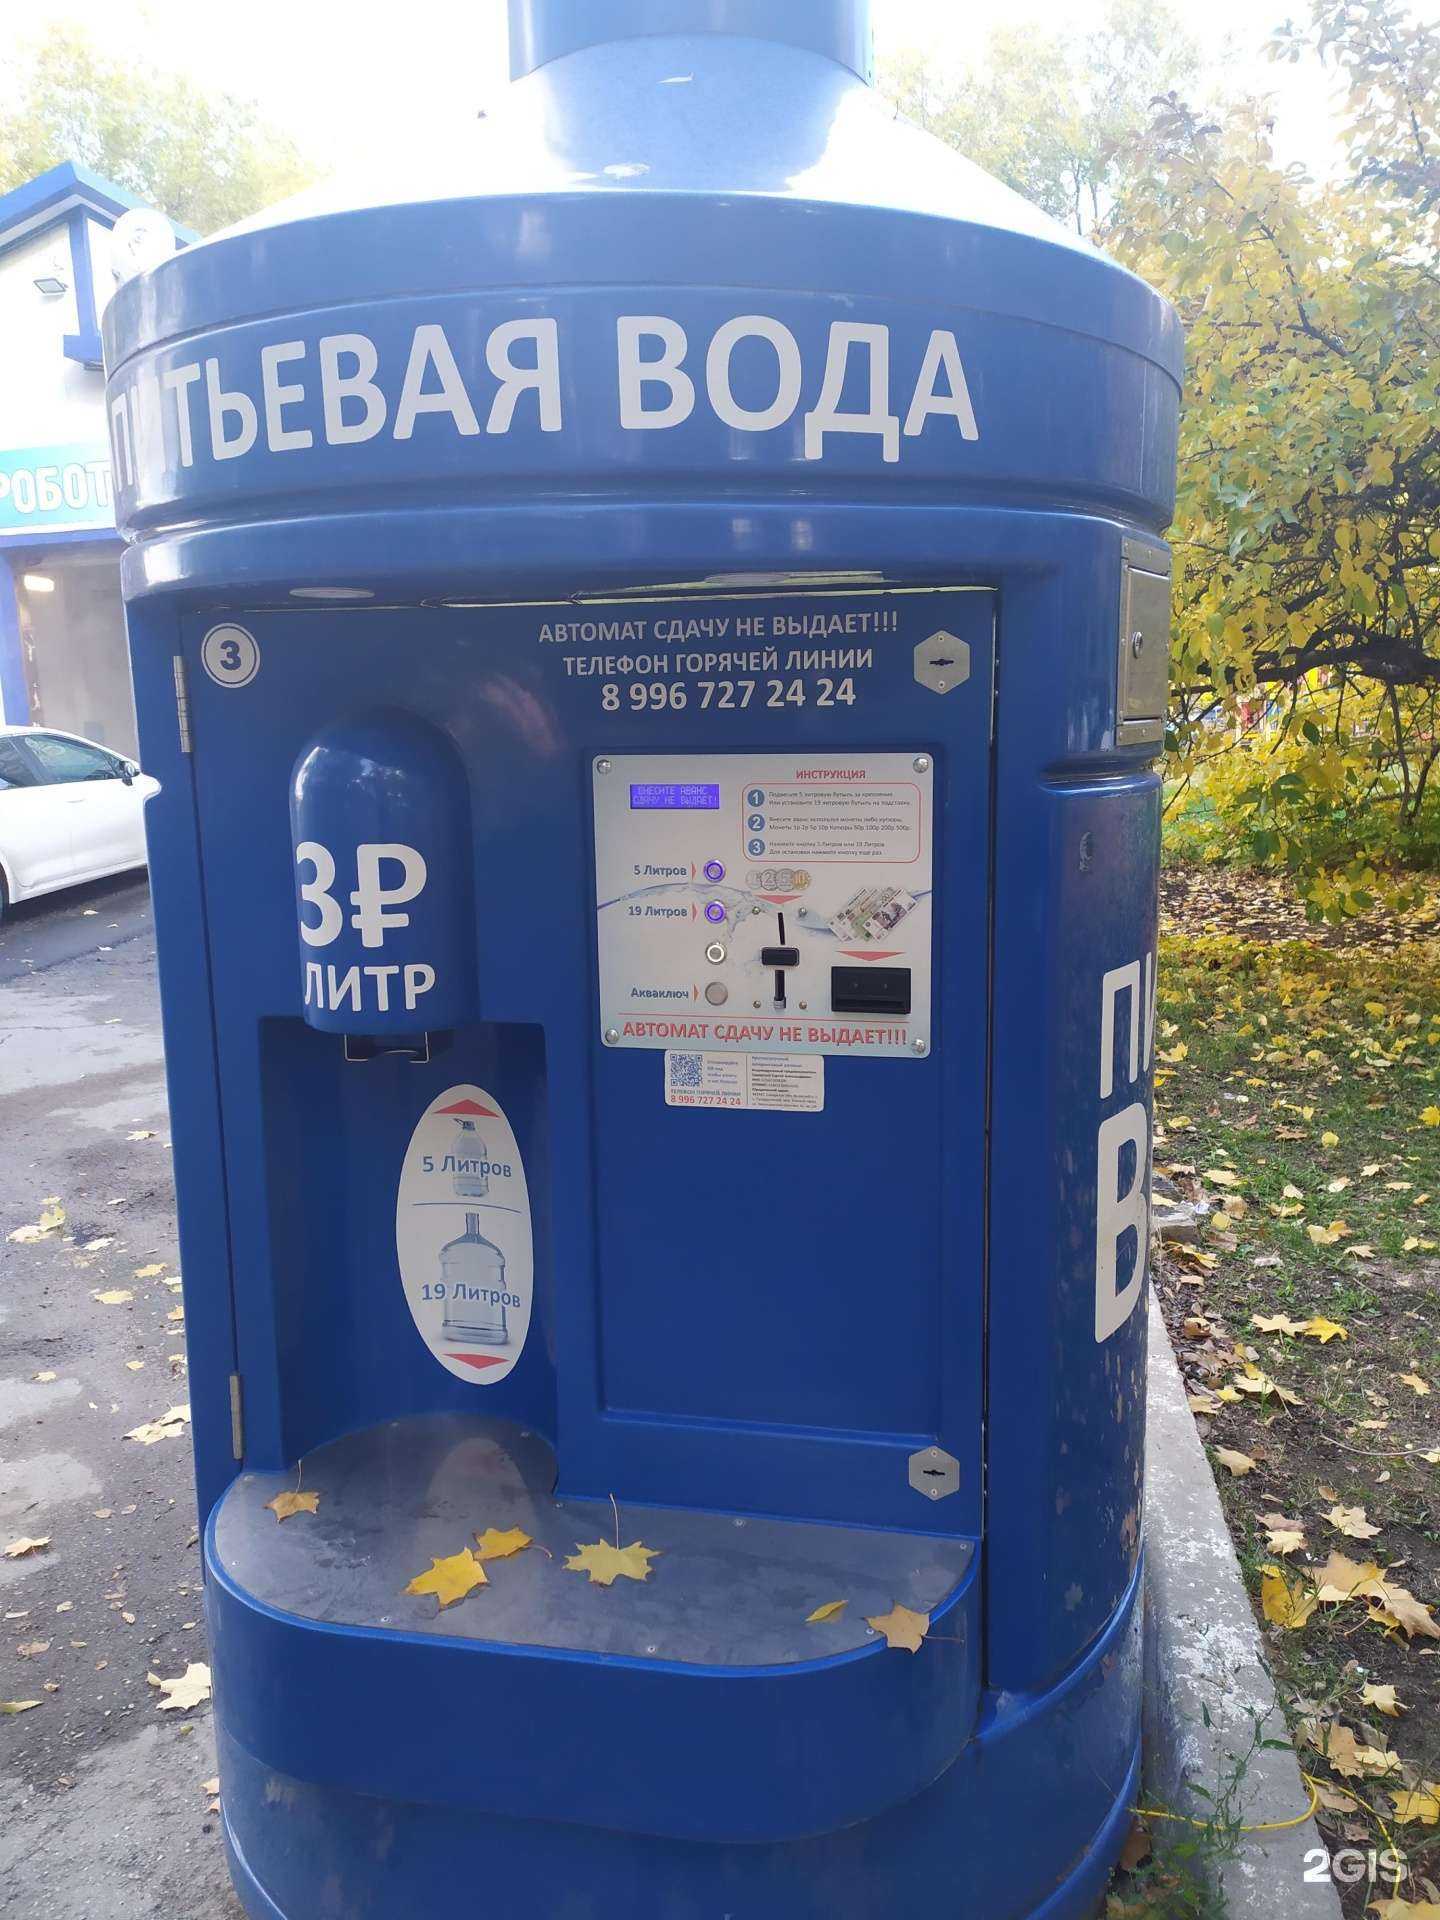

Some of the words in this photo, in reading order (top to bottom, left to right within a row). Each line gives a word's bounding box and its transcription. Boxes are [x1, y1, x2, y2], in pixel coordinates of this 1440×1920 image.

[616, 315, 979, 462] ВОДА
[539, 620, 647, 643] АВТОМАТ
[653, 617, 730, 643] СДАЧУ
[736, 616, 765, 637] НЕ
[772, 611, 898, 639] ВЫДАЕТ!!!
[220, 640, 241, 670] 3
[563, 653, 668, 676] ТЕЛЕФОН
[675, 646, 779, 673] ГОРЯЧЕЙ
[785, 648, 873, 671] ЛИНИИ
[601, 683, 620, 711] 8
[629, 682, 687, 711] 996
[698, 680, 756, 709] 727
[766, 678, 806, 708] 24
[816, 677, 856, 707] 24
[796, 769, 866, 780] ИНСТРУКЦИЯ
[752, 816, 761, 829] 2
[752, 840, 761, 854] 3
[634, 864, 641, 876] 5
[643, 864, 687, 878] Литров
[628, 906, 642, 916] 19
[644, 906, 688, 919] Литров
[304, 962, 436, 1012] ЛИТР
[630, 988, 689, 999] Акваключ
[622, 1021, 709, 1040] АВТОМАТ
[713, 1023, 774, 1043] СДАЧУ
[779, 1026, 803, 1042] НЕ
[807, 1027, 908, 1047] ВЫДАЕТ!!!
[422, 1156, 434, 1173] 5
[441, 1155, 512, 1178] Литров
[421, 1283, 446, 1301] 19
[452, 1283, 521, 1308] Литров
